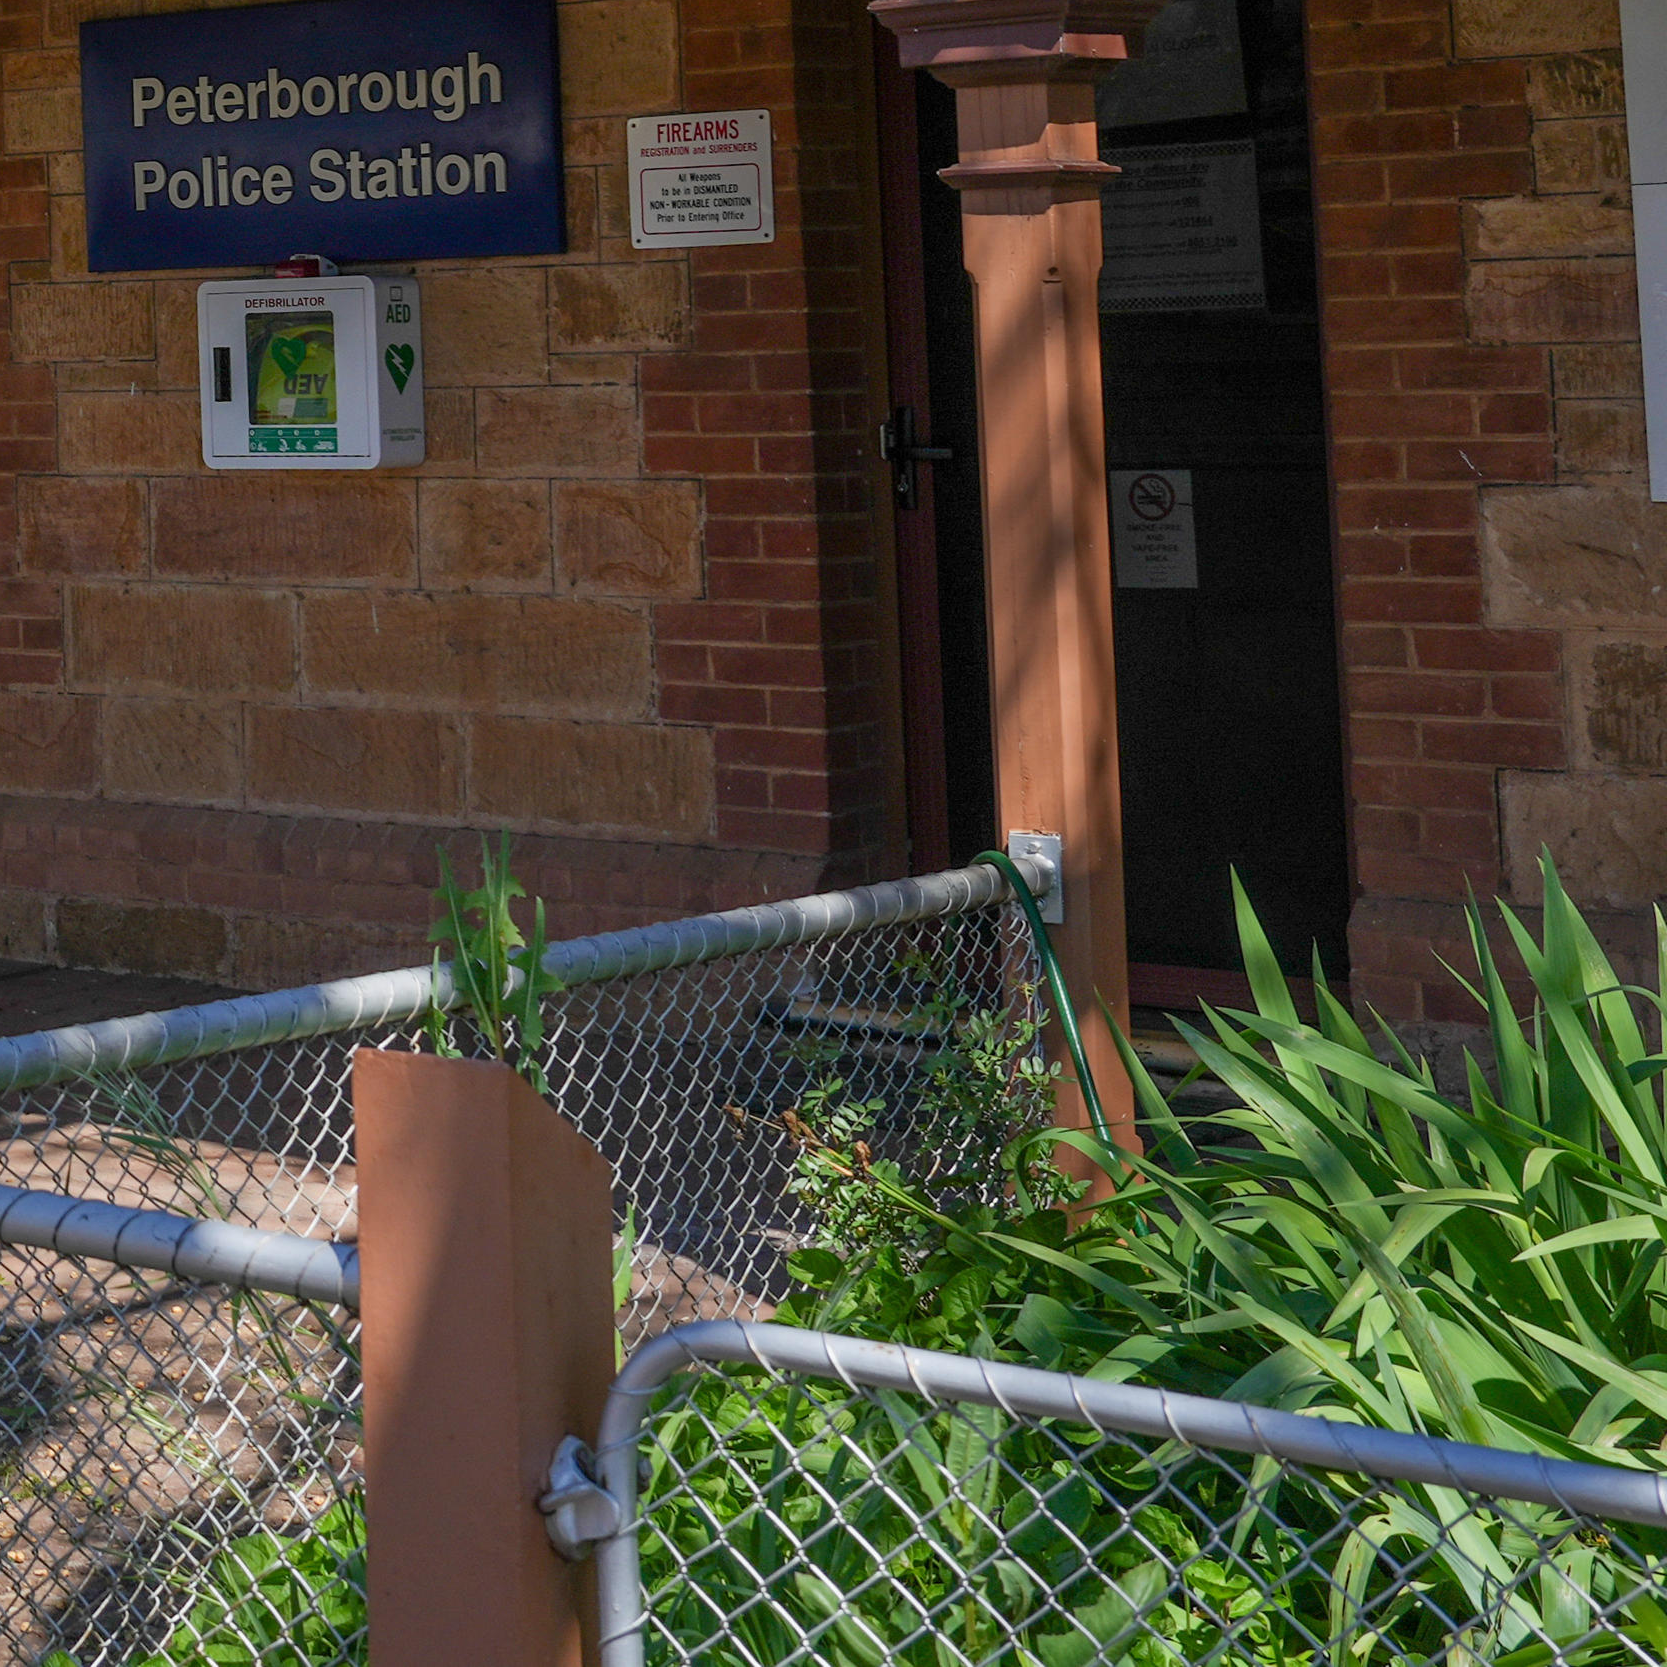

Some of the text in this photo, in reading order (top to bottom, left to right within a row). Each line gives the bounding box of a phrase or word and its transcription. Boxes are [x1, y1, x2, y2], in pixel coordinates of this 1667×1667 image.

[132, 52, 503, 129] Peterborough
[657, 119, 740, 143] FIREARMS
[640, 142, 758, 158] REGISTRATION and SURRENDERS
[133, 143, 508, 212] Police Station
[678, 172, 721, 183] All Weapons
[661, 184, 739, 196] to be in DISMANTLED
[713, 197, 752, 208] CONDITION
[657, 211, 746, 223] Prior to Entering Office
[244, 296, 325, 309] DEFIBRILLATOR
[386, 303, 411, 324] AED
[283, 373, 329, 395] AED
